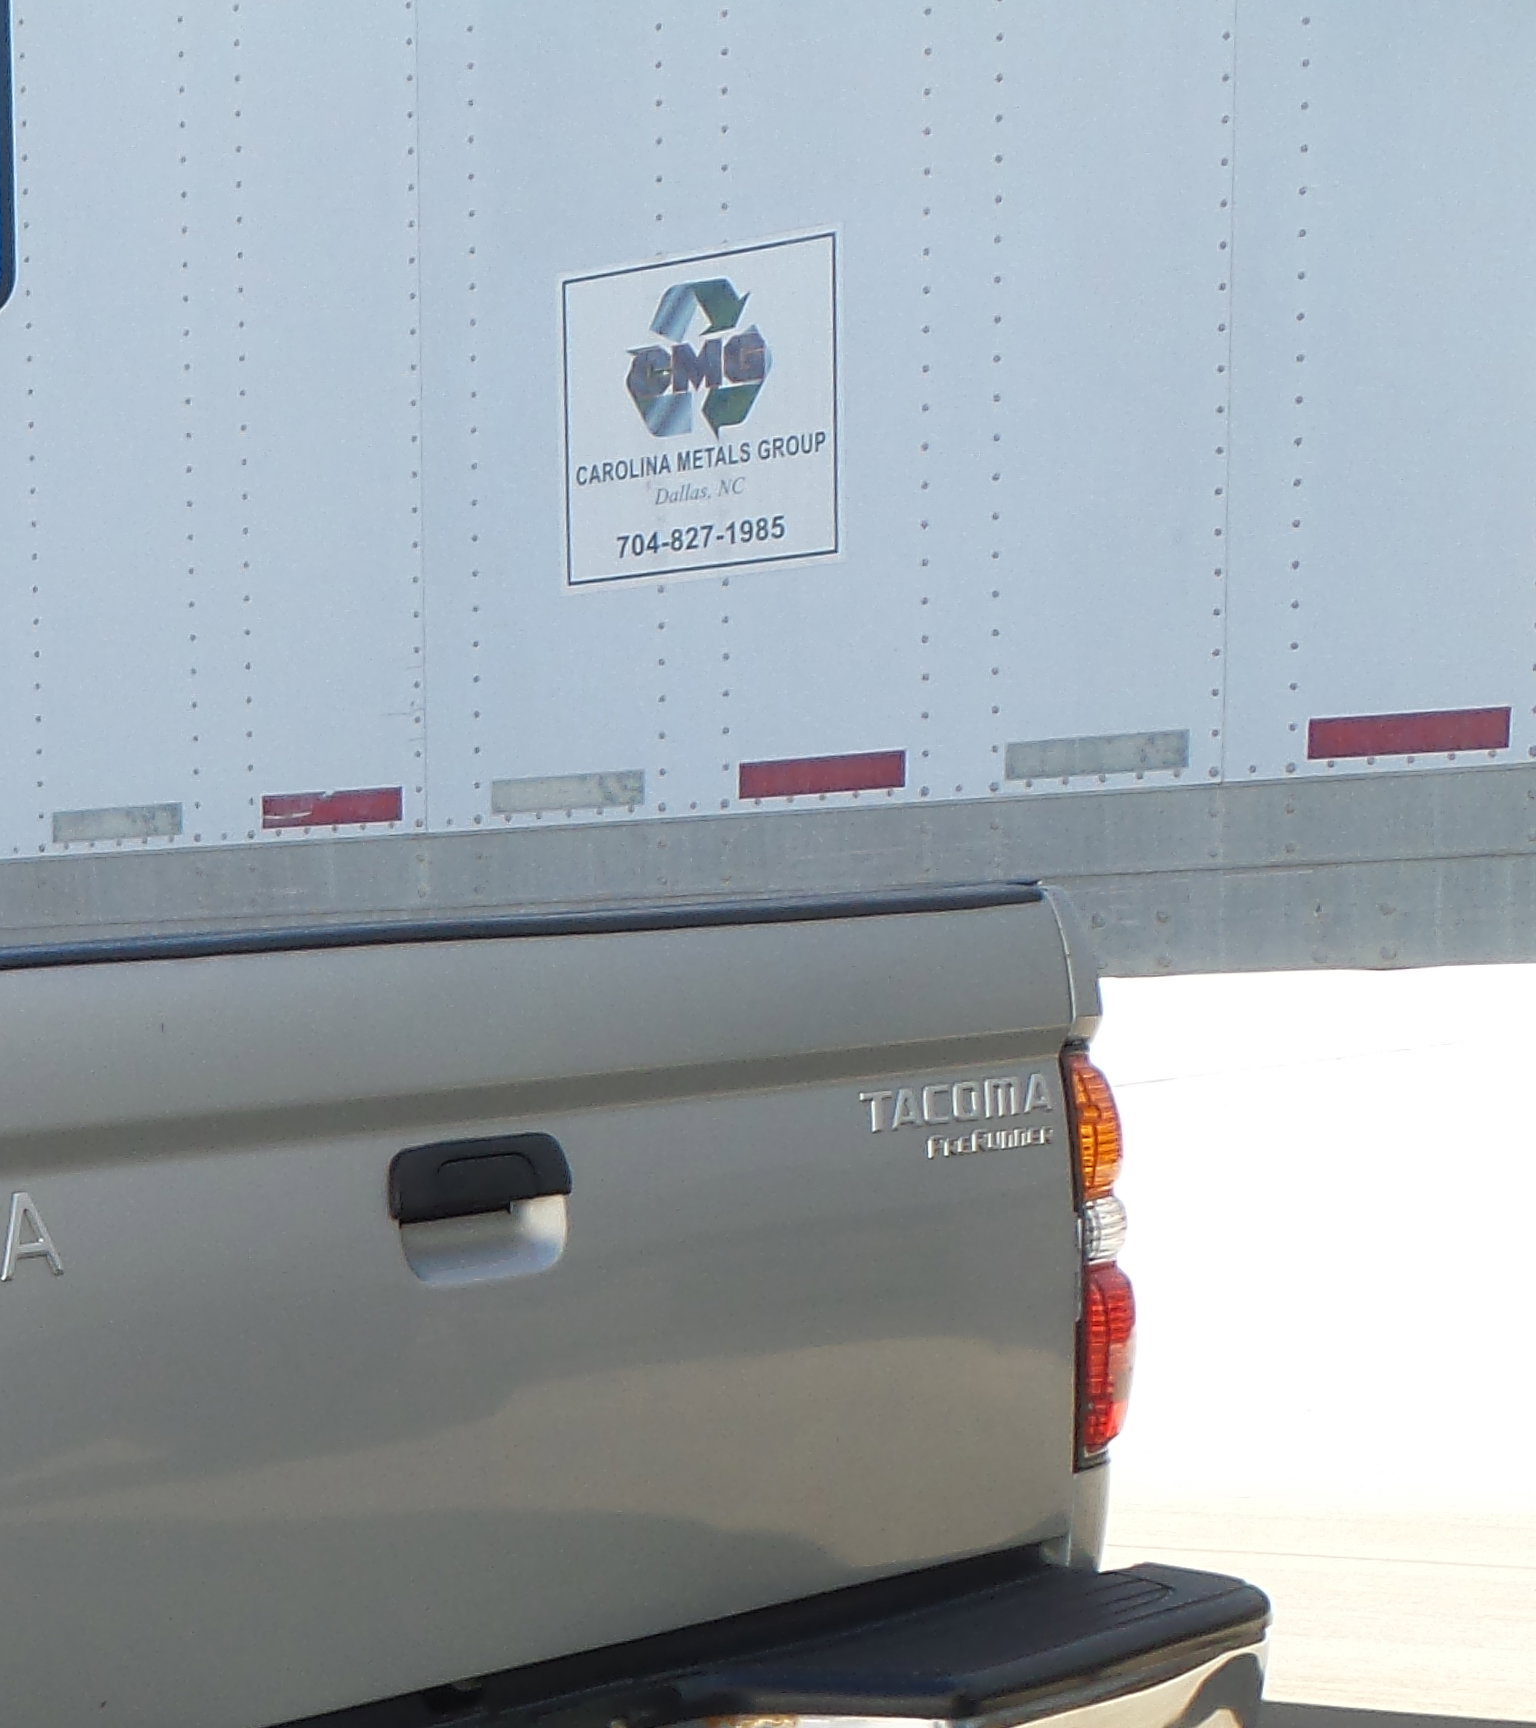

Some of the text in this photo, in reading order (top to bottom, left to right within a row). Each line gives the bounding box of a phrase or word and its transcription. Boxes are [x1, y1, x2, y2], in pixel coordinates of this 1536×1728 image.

[576, 431, 826, 486] CAROLINA METALS GROUP
[655, 476, 746, 505] Dallas, NC
[616, 515, 786, 559] 704-827-1985
[859, 1073, 1052, 1134] TACOMA
